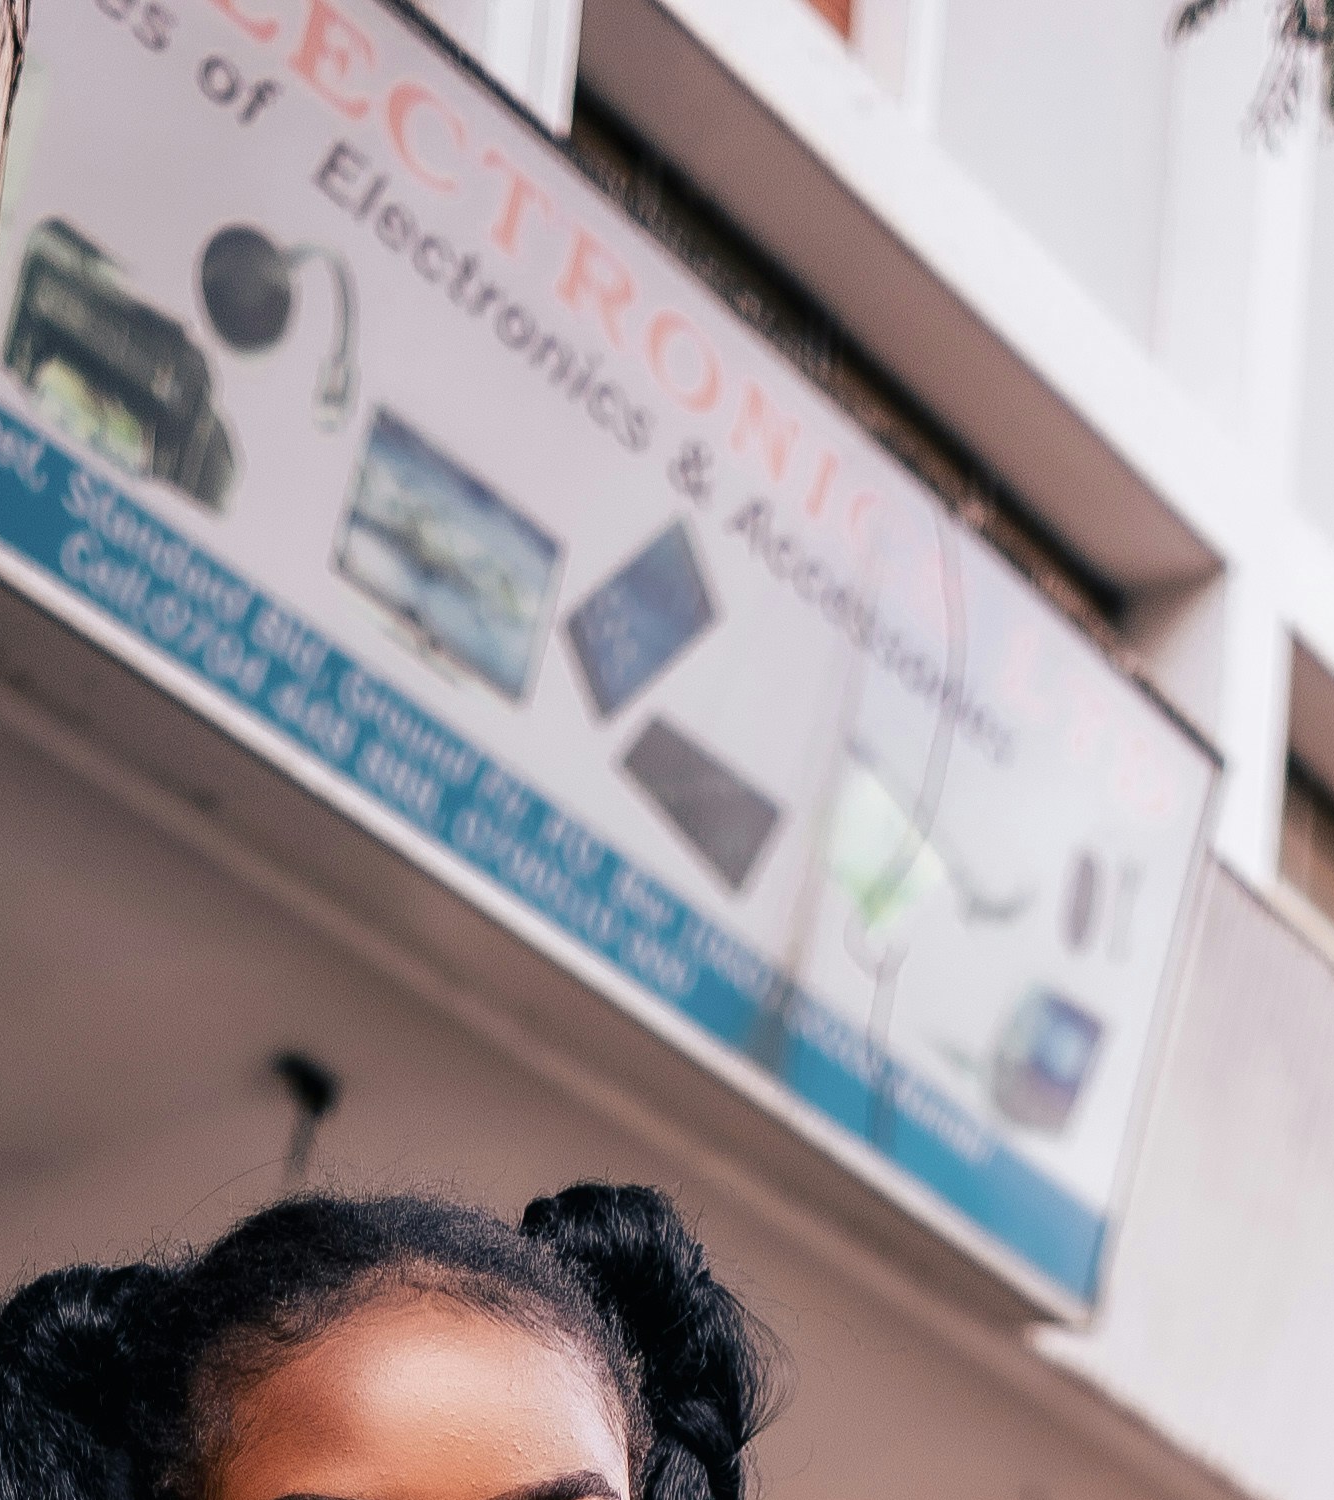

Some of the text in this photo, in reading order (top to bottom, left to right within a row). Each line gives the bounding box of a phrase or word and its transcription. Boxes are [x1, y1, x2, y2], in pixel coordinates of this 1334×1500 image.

[195, 53, 282, 127] of
[310, 140, 655, 453] Electronics
[668, 438, 713, 508] &
